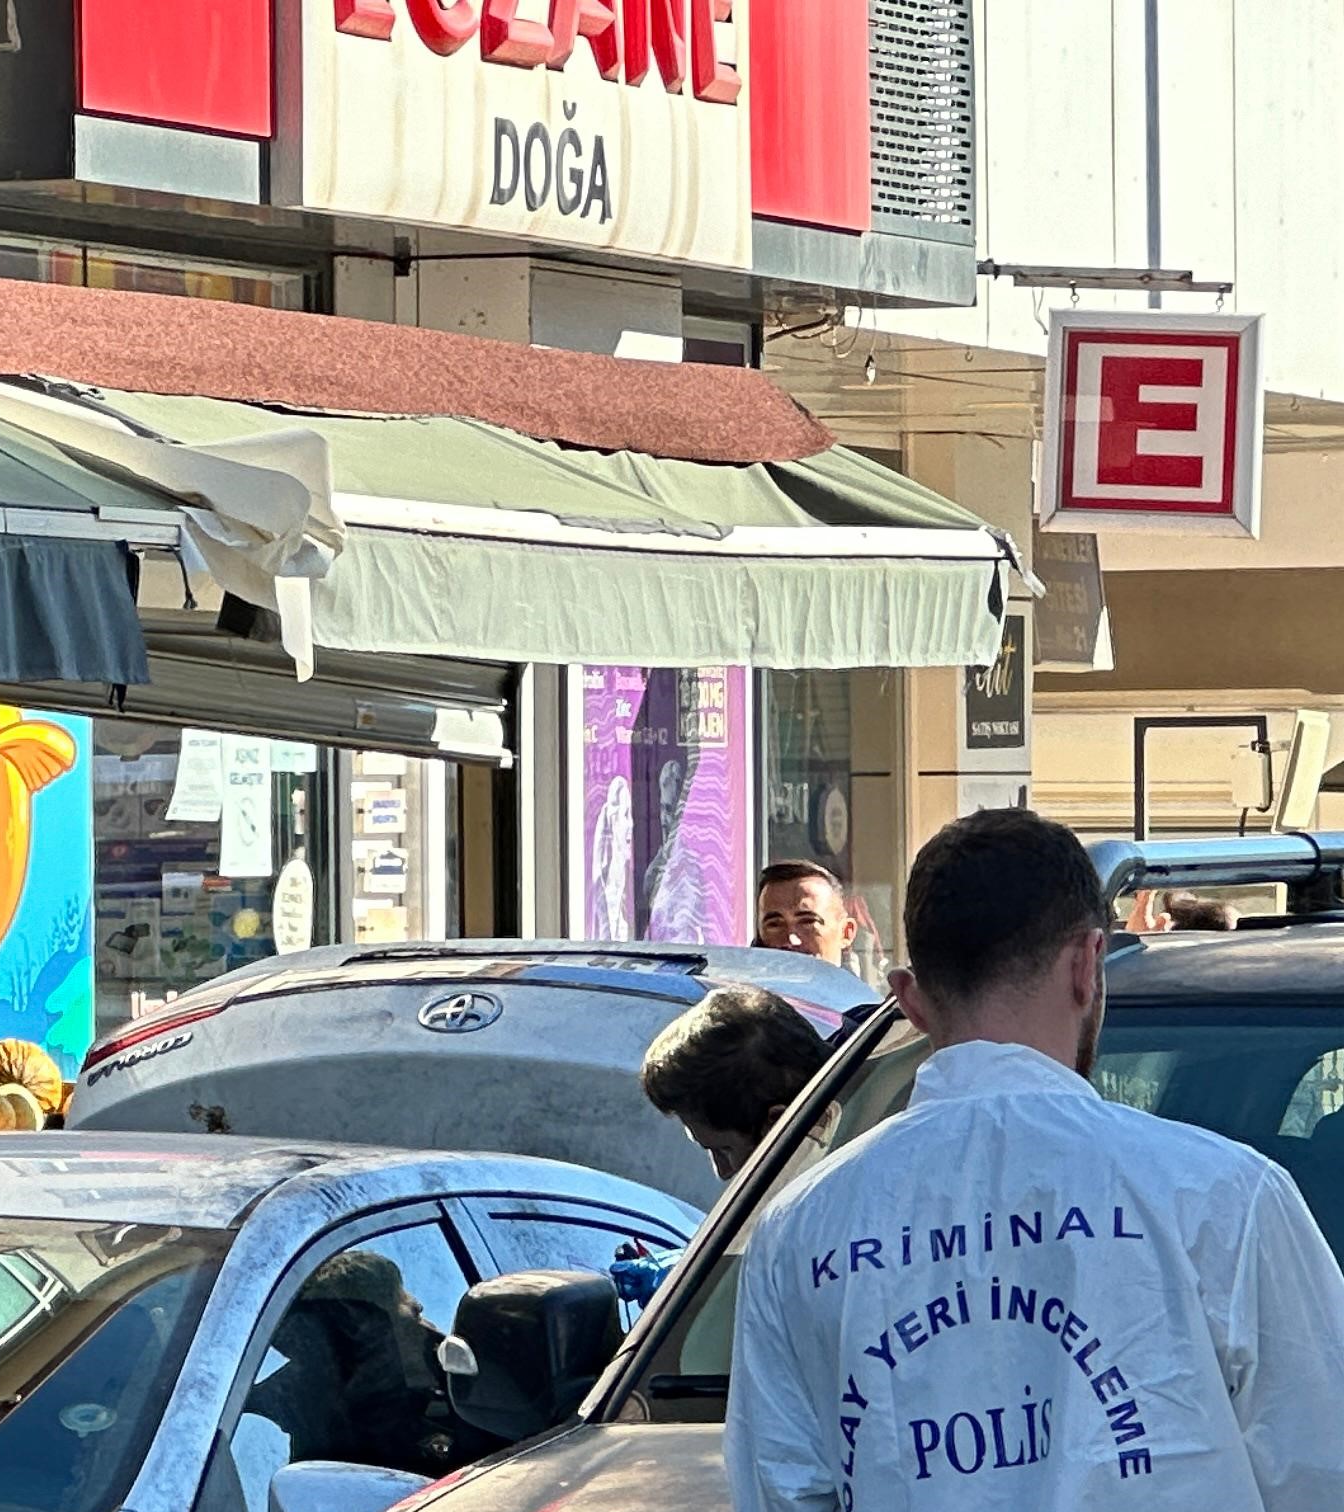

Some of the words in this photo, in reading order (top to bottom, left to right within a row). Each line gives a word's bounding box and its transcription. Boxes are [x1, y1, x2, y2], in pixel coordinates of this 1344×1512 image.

[490, 100, 614, 225] DOĞA
[1097, 356, 1204, 489] E
[812, 1205, 1144, 1288] KRİMİNAL
[864, 1280, 972, 1372] YERİ
[989, 1276, 1153, 1479] İNCELEME
[908, 1384, 1054, 1480] POLİS
